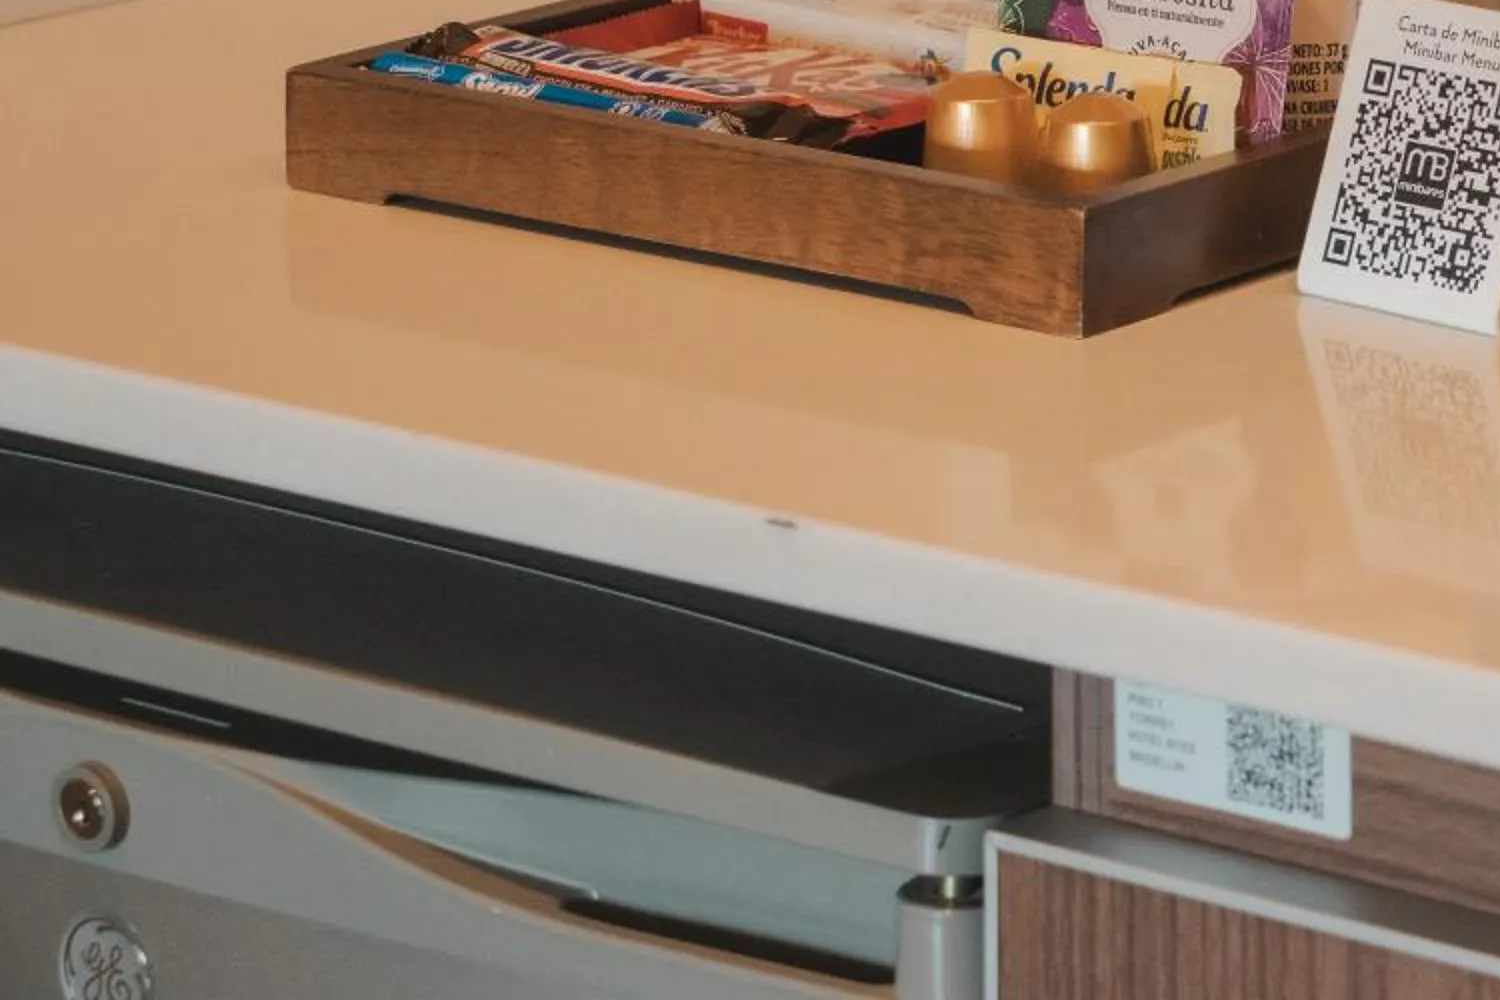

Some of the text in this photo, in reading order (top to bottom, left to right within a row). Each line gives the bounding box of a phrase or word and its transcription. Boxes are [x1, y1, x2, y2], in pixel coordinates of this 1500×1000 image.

[1398, 15, 1437, 37] Carta
[1441, 21, 1459, 41] de
[1403, 39, 1500, 71] Minibar Menu
